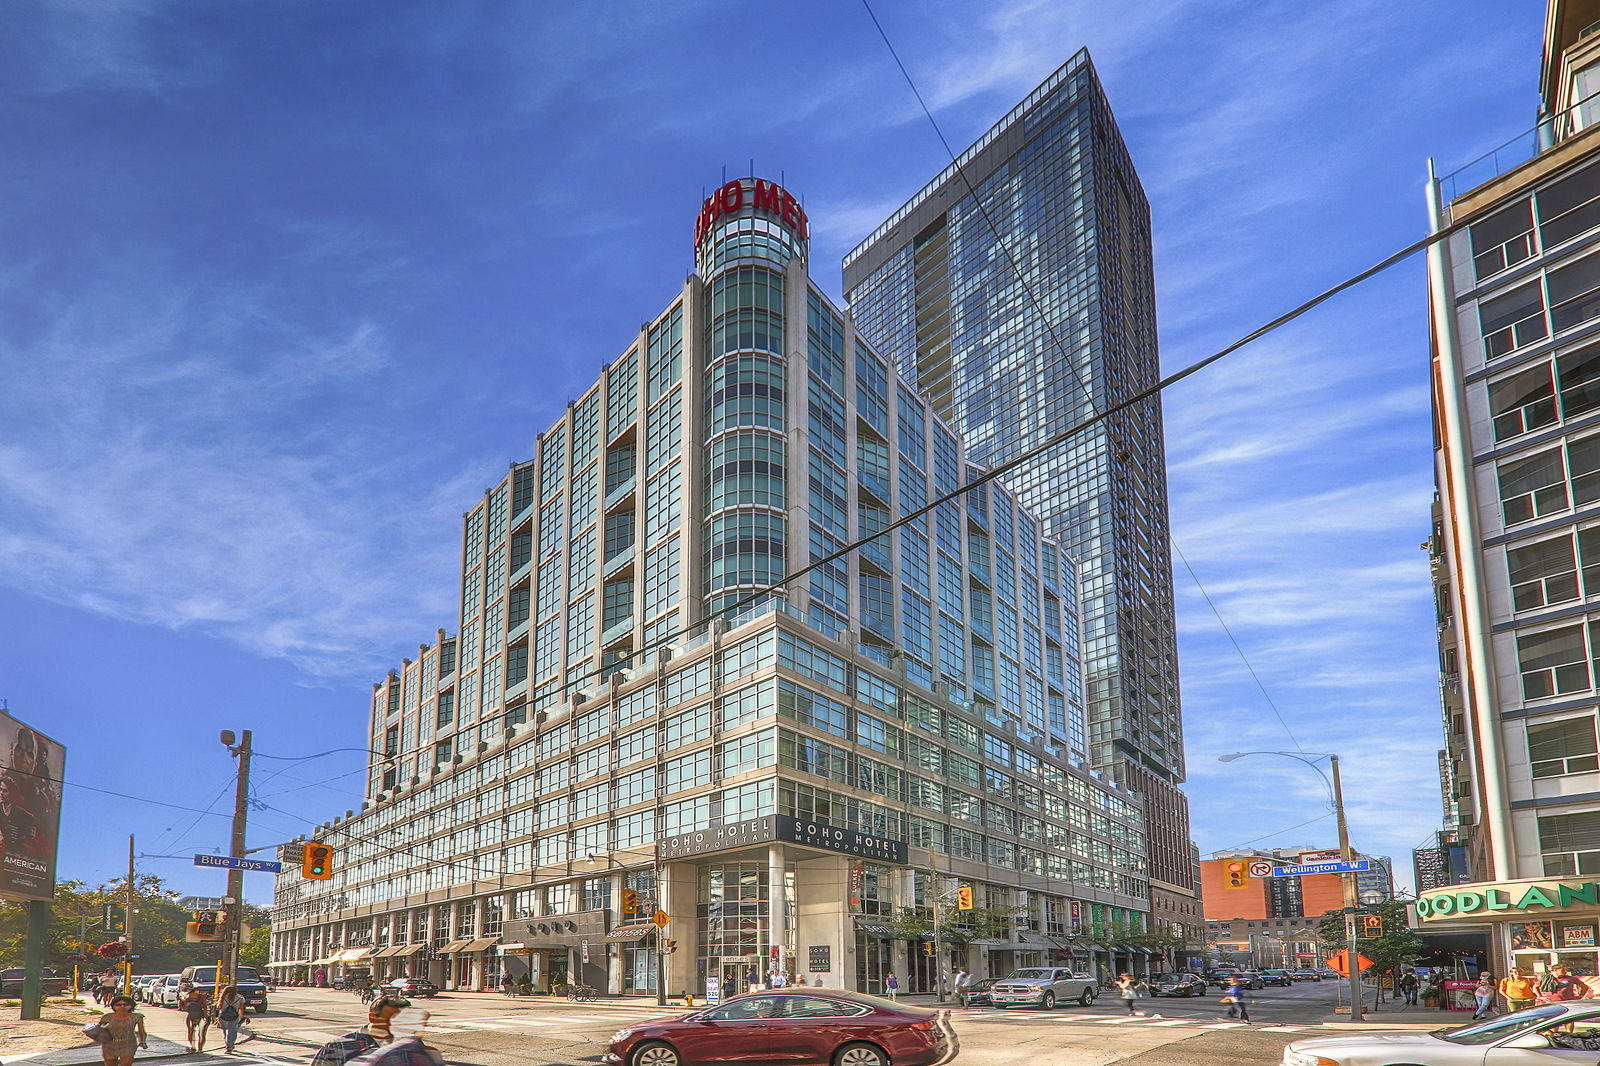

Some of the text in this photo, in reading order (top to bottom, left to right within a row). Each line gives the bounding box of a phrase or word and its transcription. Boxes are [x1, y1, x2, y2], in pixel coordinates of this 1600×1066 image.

[660, 819, 769, 851] SOHO HOTEL
[660, 832, 770, 858] METROPOLITAN
[795, 820, 897, 853] SOHO HOTEL
[795, 834, 898, 861] METROPOLITAN
[3, 856, 47, 873] AMERICAN
[201, 855, 230, 866] Blue
[235, 860, 262, 870] Jays
[1282, 863, 1338, 874] Wellington
[1349, 861, 1360, 869] W
[1416, 882, 1600, 917] OODLAN
[606, 928, 649, 938] senses
[1568, 930, 1590, 939] ABM
